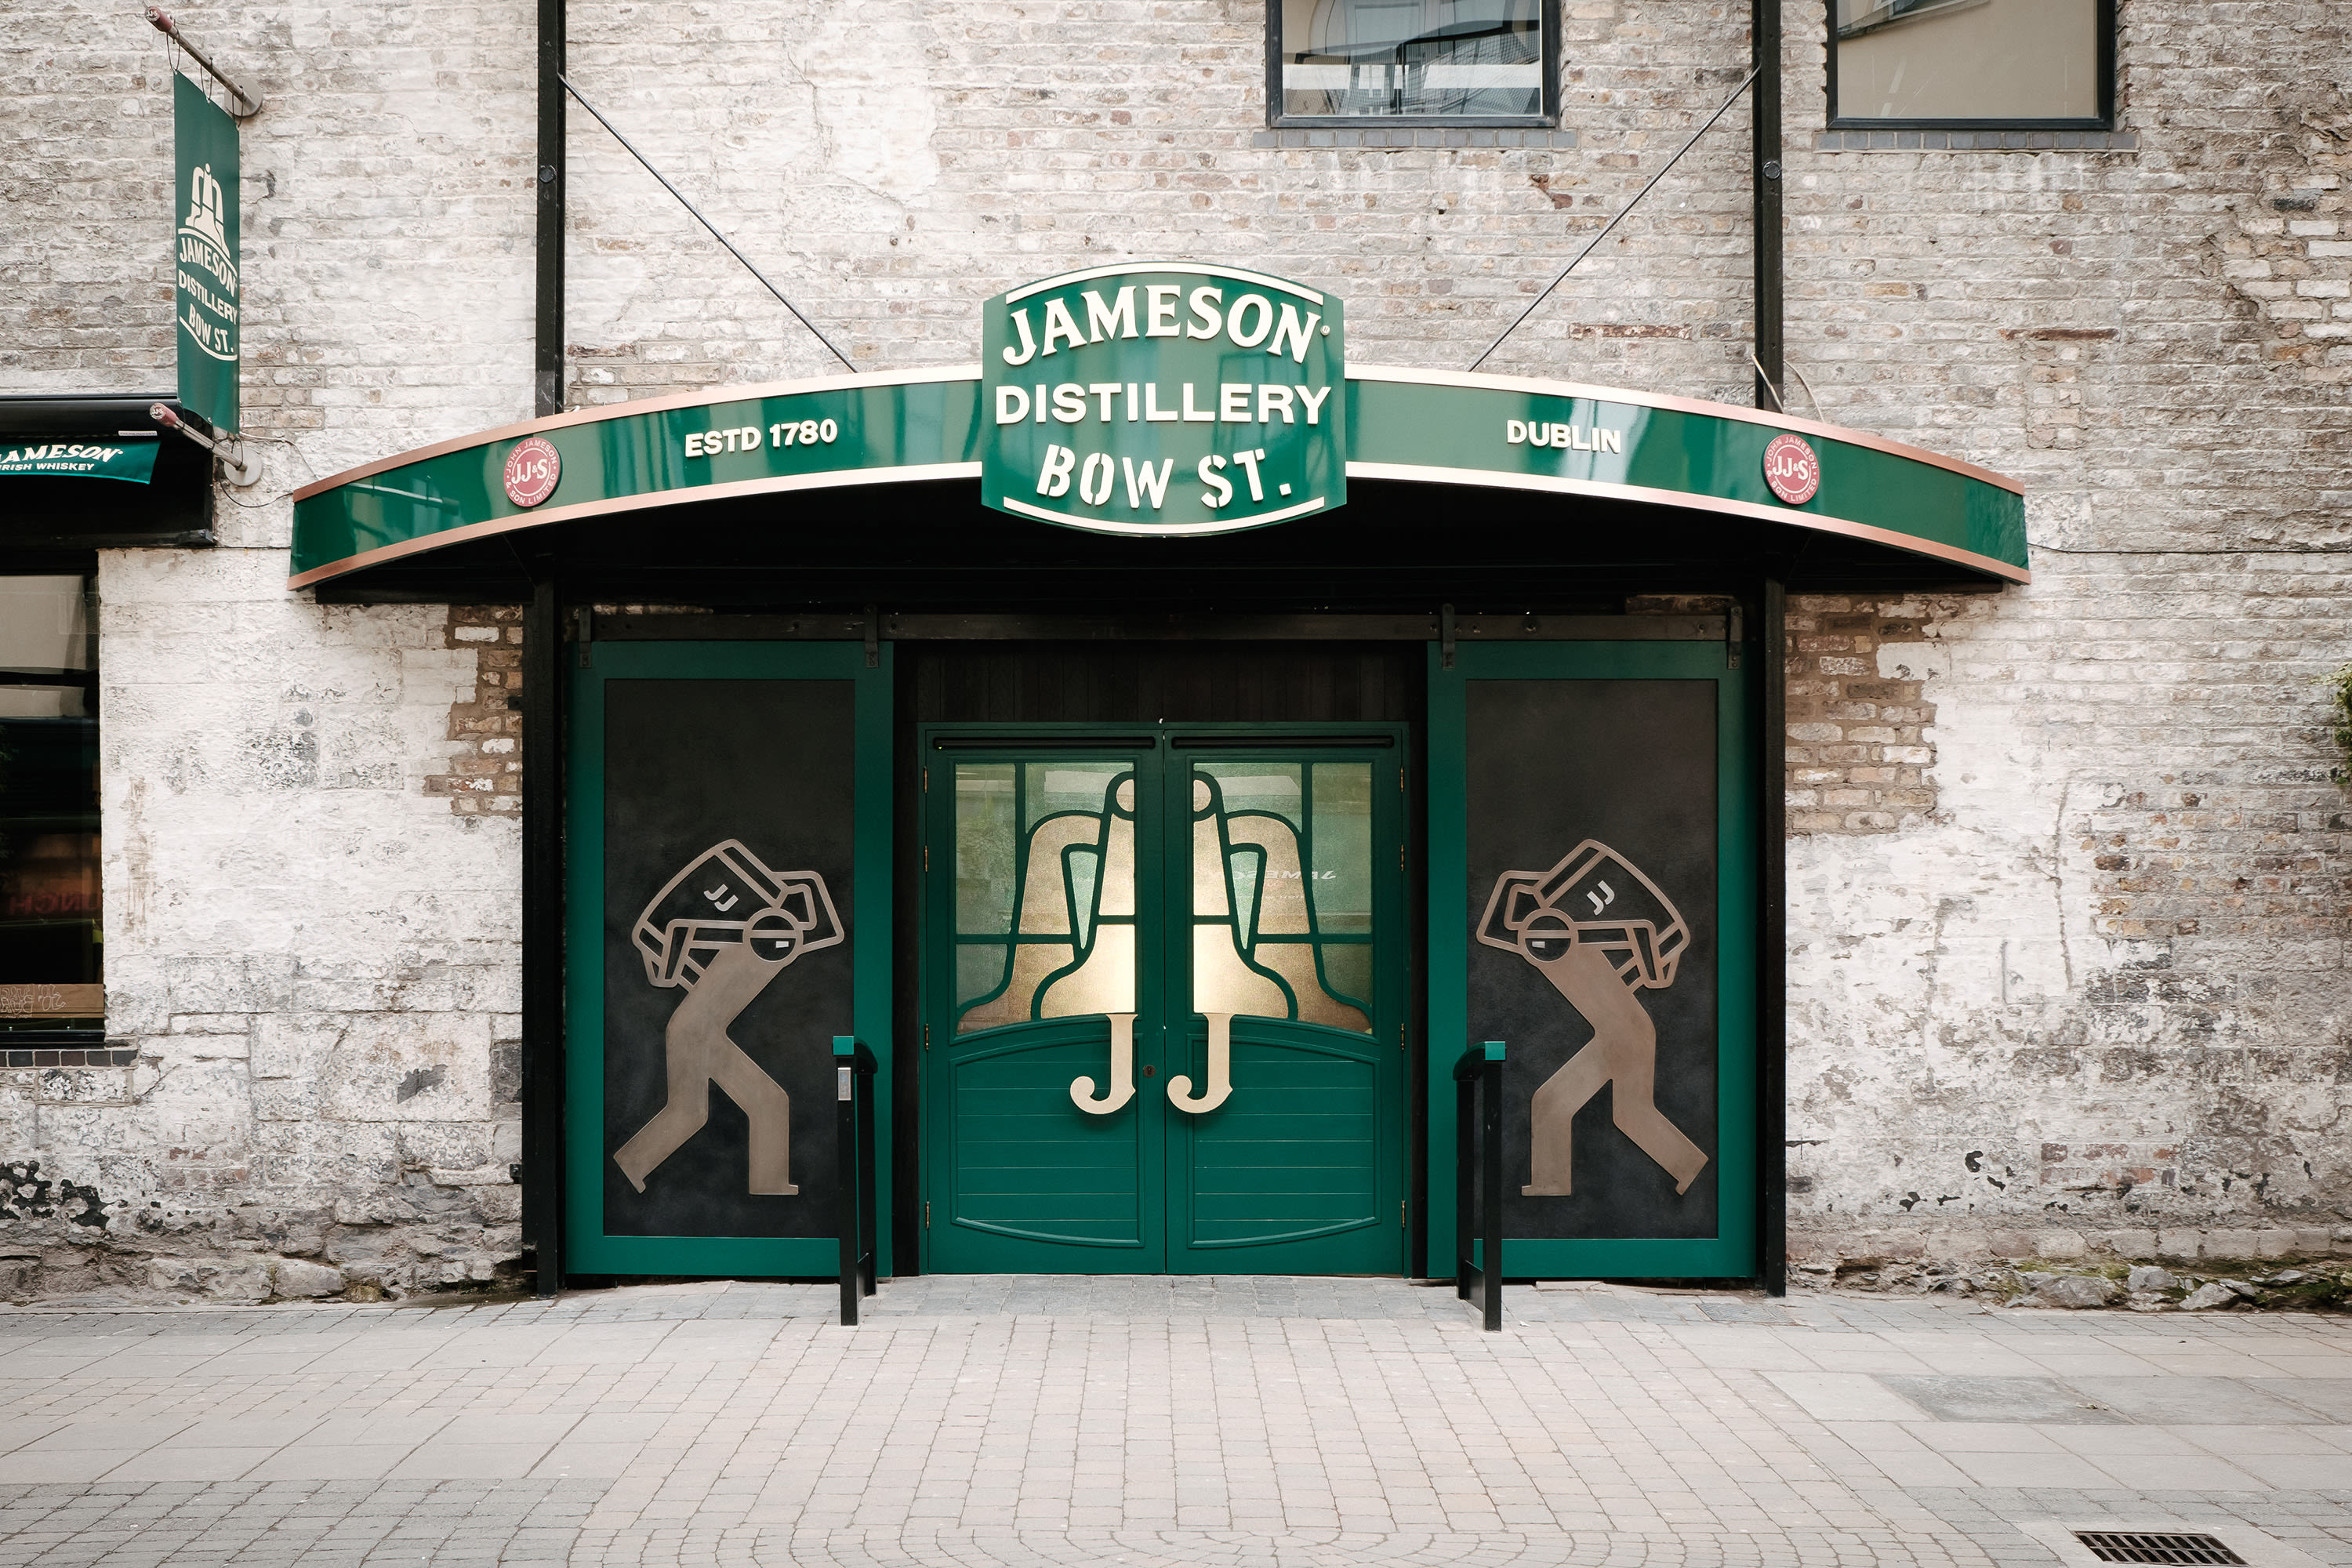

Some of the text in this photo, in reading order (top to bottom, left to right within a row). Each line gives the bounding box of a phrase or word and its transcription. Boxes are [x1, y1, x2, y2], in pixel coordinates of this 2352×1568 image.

[180, 237, 236, 297] JAMESON
[179, 268, 238, 325] DISTILLERY
[189, 303, 234, 353] BOW ST.
[1002, 285, 1322, 366] JAMESON
[996, 383, 1332, 425] DISTILLERY
[685, 418, 838, 458] ESTD 1780
[1507, 419, 1621, 454] DUBLIN
[1766, 436, 1817, 470] JOHN JAMESON
[0, 445, 118, 464] AMESON
[37, 463, 94, 471] WHISKEY
[506, 439, 557, 474] JOHN JAMESON
[511, 458, 548, 485] JJ&S
[1772, 456, 1809, 481] JJ&S
[506, 473, 557, 504] & SON LIMITED
[1036, 444, 1292, 510] BOW ST.
[1771, 480, 1788, 499] SON
[1790, 477, 1817, 503] LIMITED
[703, 884, 739, 912] JJ
[1586, 880, 1615, 916] JJ
